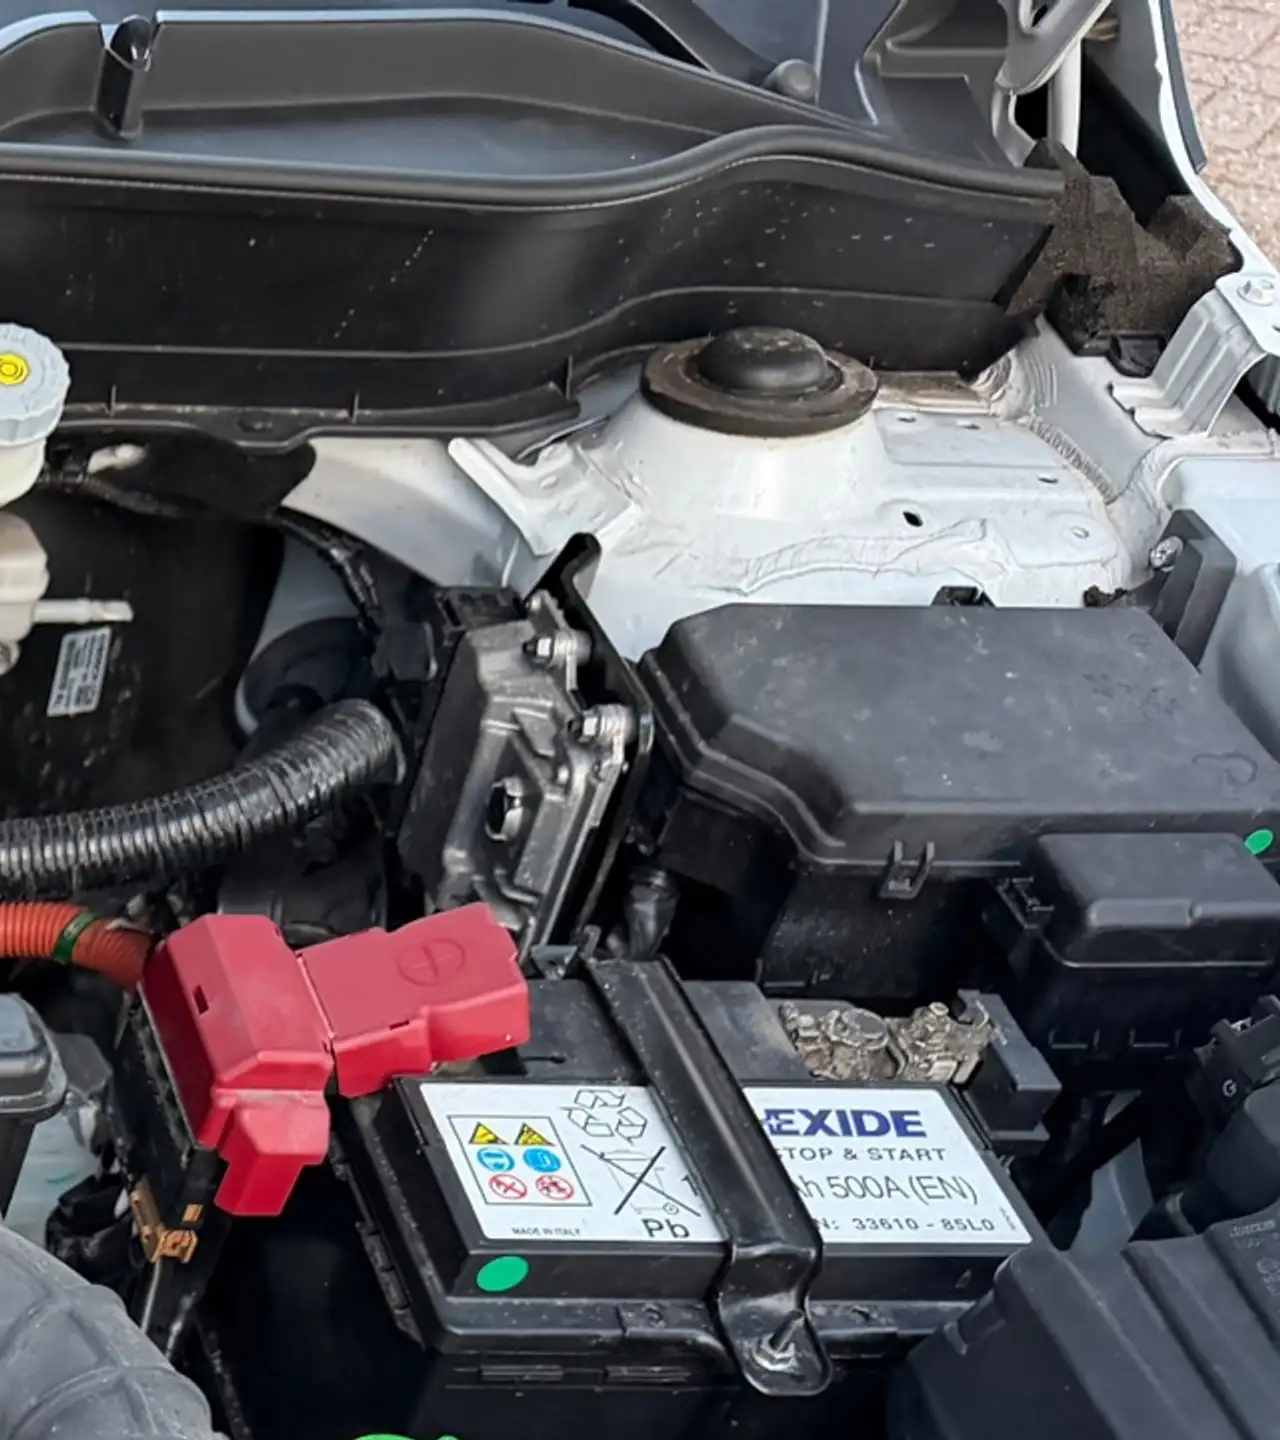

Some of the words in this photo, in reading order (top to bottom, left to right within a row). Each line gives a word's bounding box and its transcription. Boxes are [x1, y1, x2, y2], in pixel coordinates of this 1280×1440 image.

[763, 1108, 928, 1138] EXIDE
[843, 1147, 858, 1161] &
[866, 1147, 947, 1162] START
[511, 1227, 539, 1236] MADE
[554, 1227, 581, 1236] ITALY
[642, 1217, 690, 1239] Pb
[851, 1217, 919, 1231] 33610
[941, 1218, 996, 1231] 85L0
